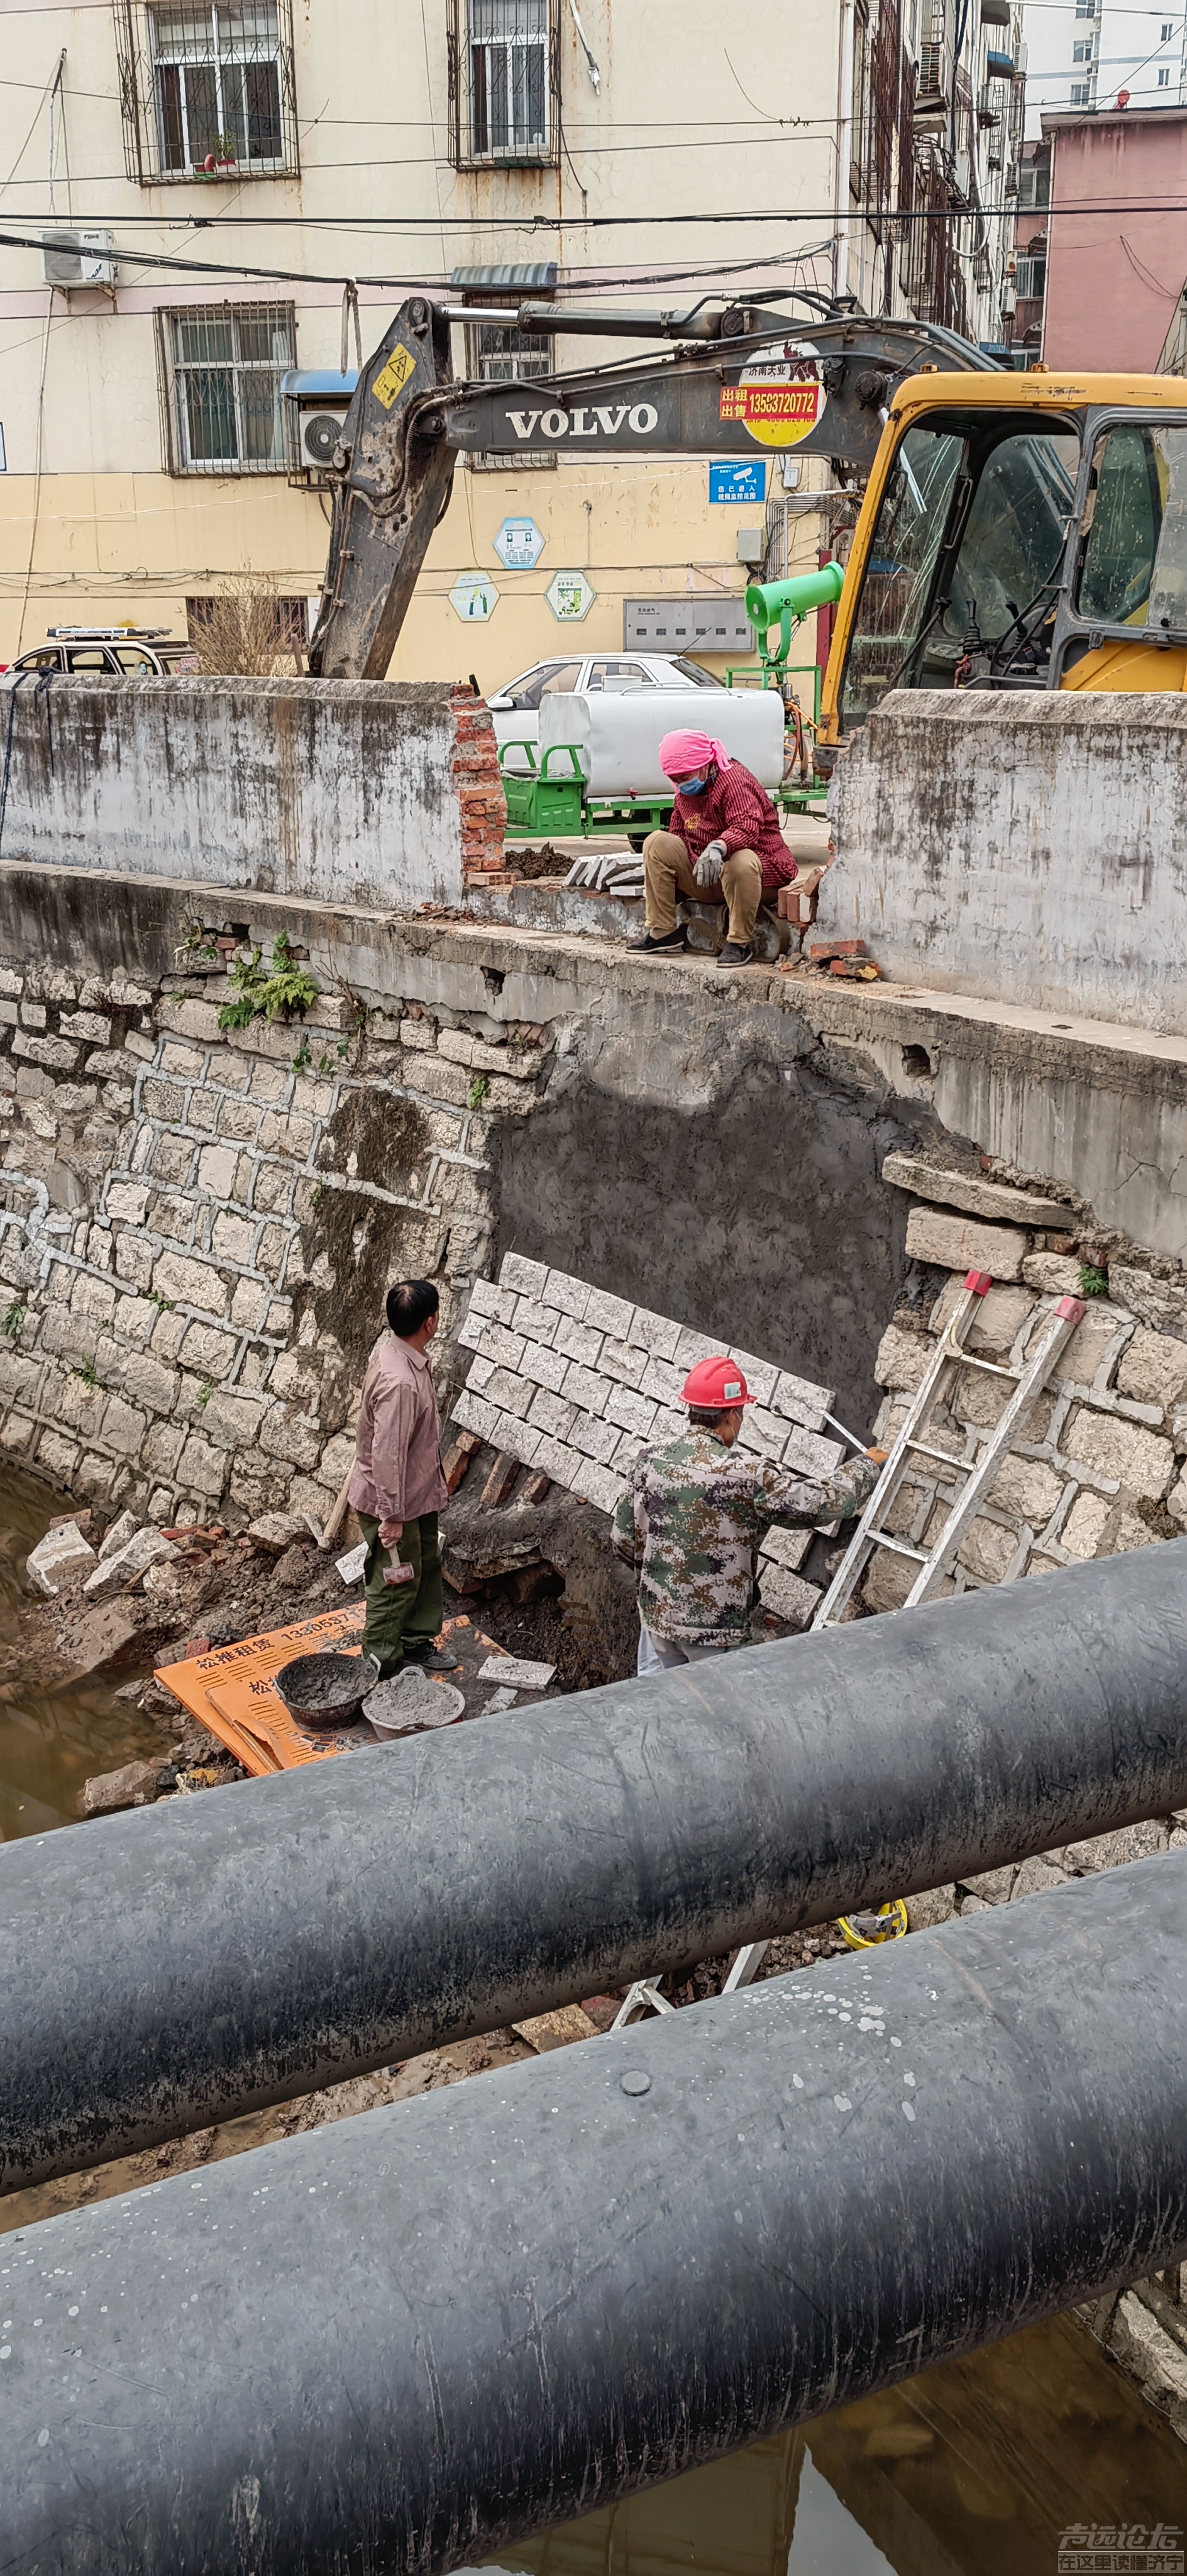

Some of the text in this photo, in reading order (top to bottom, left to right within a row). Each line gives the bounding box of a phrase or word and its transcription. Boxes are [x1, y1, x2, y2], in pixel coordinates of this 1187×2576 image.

[722, 389, 748, 402] 出租
[749, 392, 814, 413] 13583720772
[505, 403, 658, 438] VOLVO
[721, 404, 747, 418] 出售
[196, 1638, 275, 1670] 松推租赁
